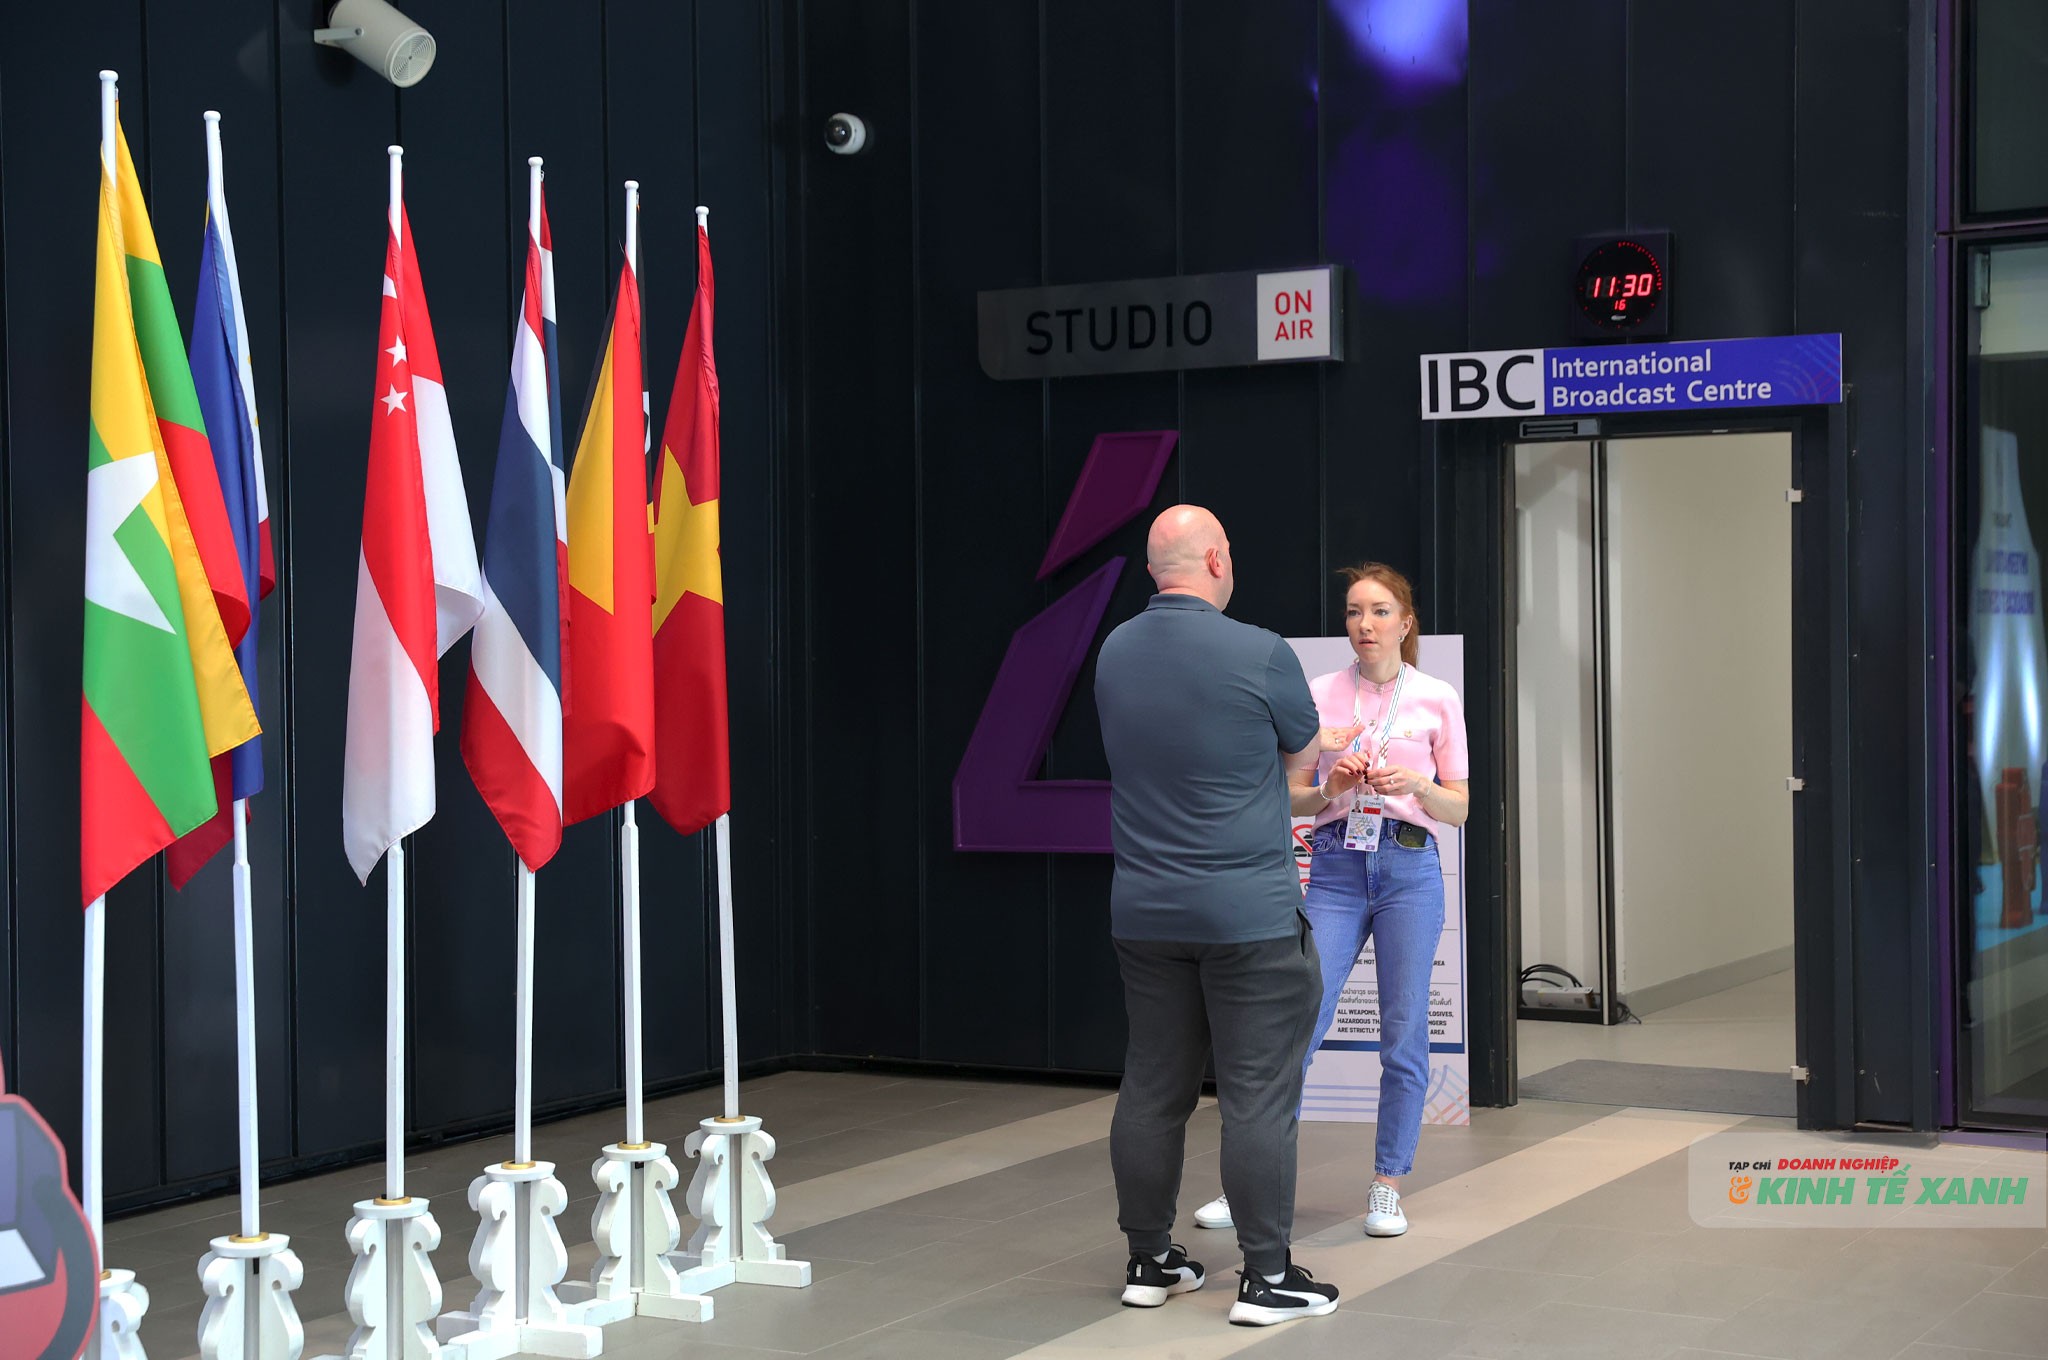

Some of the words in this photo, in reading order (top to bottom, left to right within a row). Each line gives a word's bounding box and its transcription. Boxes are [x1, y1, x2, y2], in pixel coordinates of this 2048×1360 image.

[1274, 289, 1313, 316] ON
[1026, 300, 1213, 356] STUDIO
[1274, 319, 1314, 342] AIR
[1551, 348, 1712, 379] International
[1427, 354, 1537, 413] IBC
[1552, 385, 1676, 408] Broadcast
[1686, 379, 1773, 402] Centre
[1428, 1010, 1454, 1018] LOSIVES,
